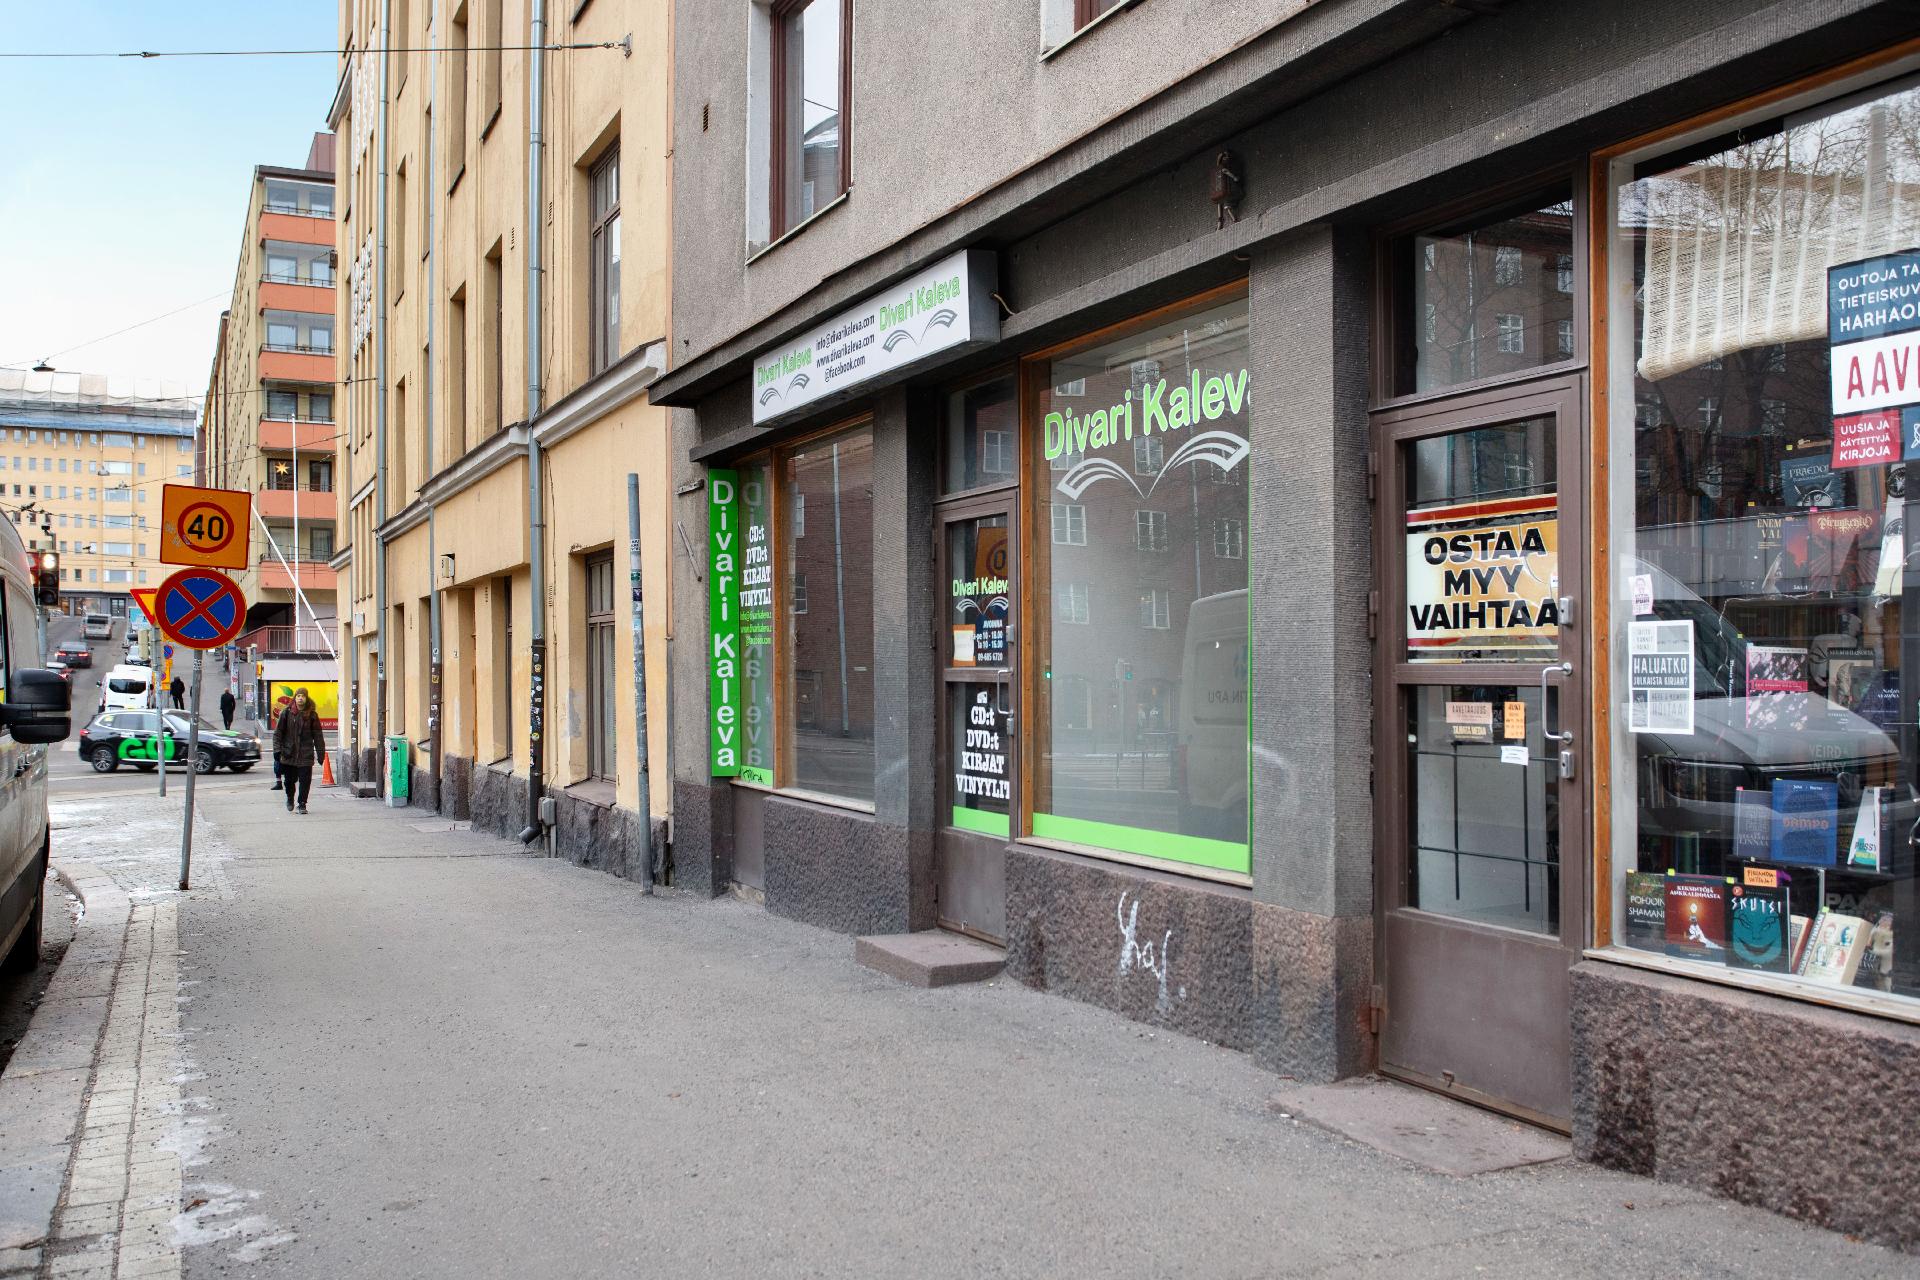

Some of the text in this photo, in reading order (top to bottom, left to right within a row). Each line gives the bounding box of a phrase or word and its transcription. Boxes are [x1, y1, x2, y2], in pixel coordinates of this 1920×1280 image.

[1838, 268, 1898, 290] OUTOJA
[879, 276, 961, 332] Divari Kaleva
[1840, 302, 1920, 333] HARHAO
[757, 347, 812, 387] Divari Kaleva
[824, 355, 866, 383] @facebook.com
[1847, 345, 1920, 400] AAV
[1044, 368, 1250, 460] Divari Kalev
[1840, 420, 1890, 435] UUSIA JA
[1840, 433, 1891, 447] KÄYTETTYJÄ
[1840, 445, 1891, 461] KIRJOJA
[188, 514, 224, 541] 40
[749, 524, 765, 543] CD:t
[713, 480, 734, 622] Divari
[746, 546, 767, 564] DVD:t
[1424, 528, 1547, 565] OSTAA
[743, 566, 771, 585] KIRJAT
[953, 576, 1008, 596] Divari Kalev
[1444, 565, 1524, 597] MYY
[1410, 598, 1559, 631] VAIHTAA
[1633, 657, 1687, 674] HALUATKO
[1634, 676, 1662, 686] JULKAISTA
[714, 633, 735, 768] Kaleva
[971, 706, 995, 726] CD:t
[966, 729, 999, 750] DVD:t
[962, 751, 1004, 774] KIRJAT
[956, 773, 1010, 800] VINYYLIT
[1731, 897, 1781, 914] SKUTSI
